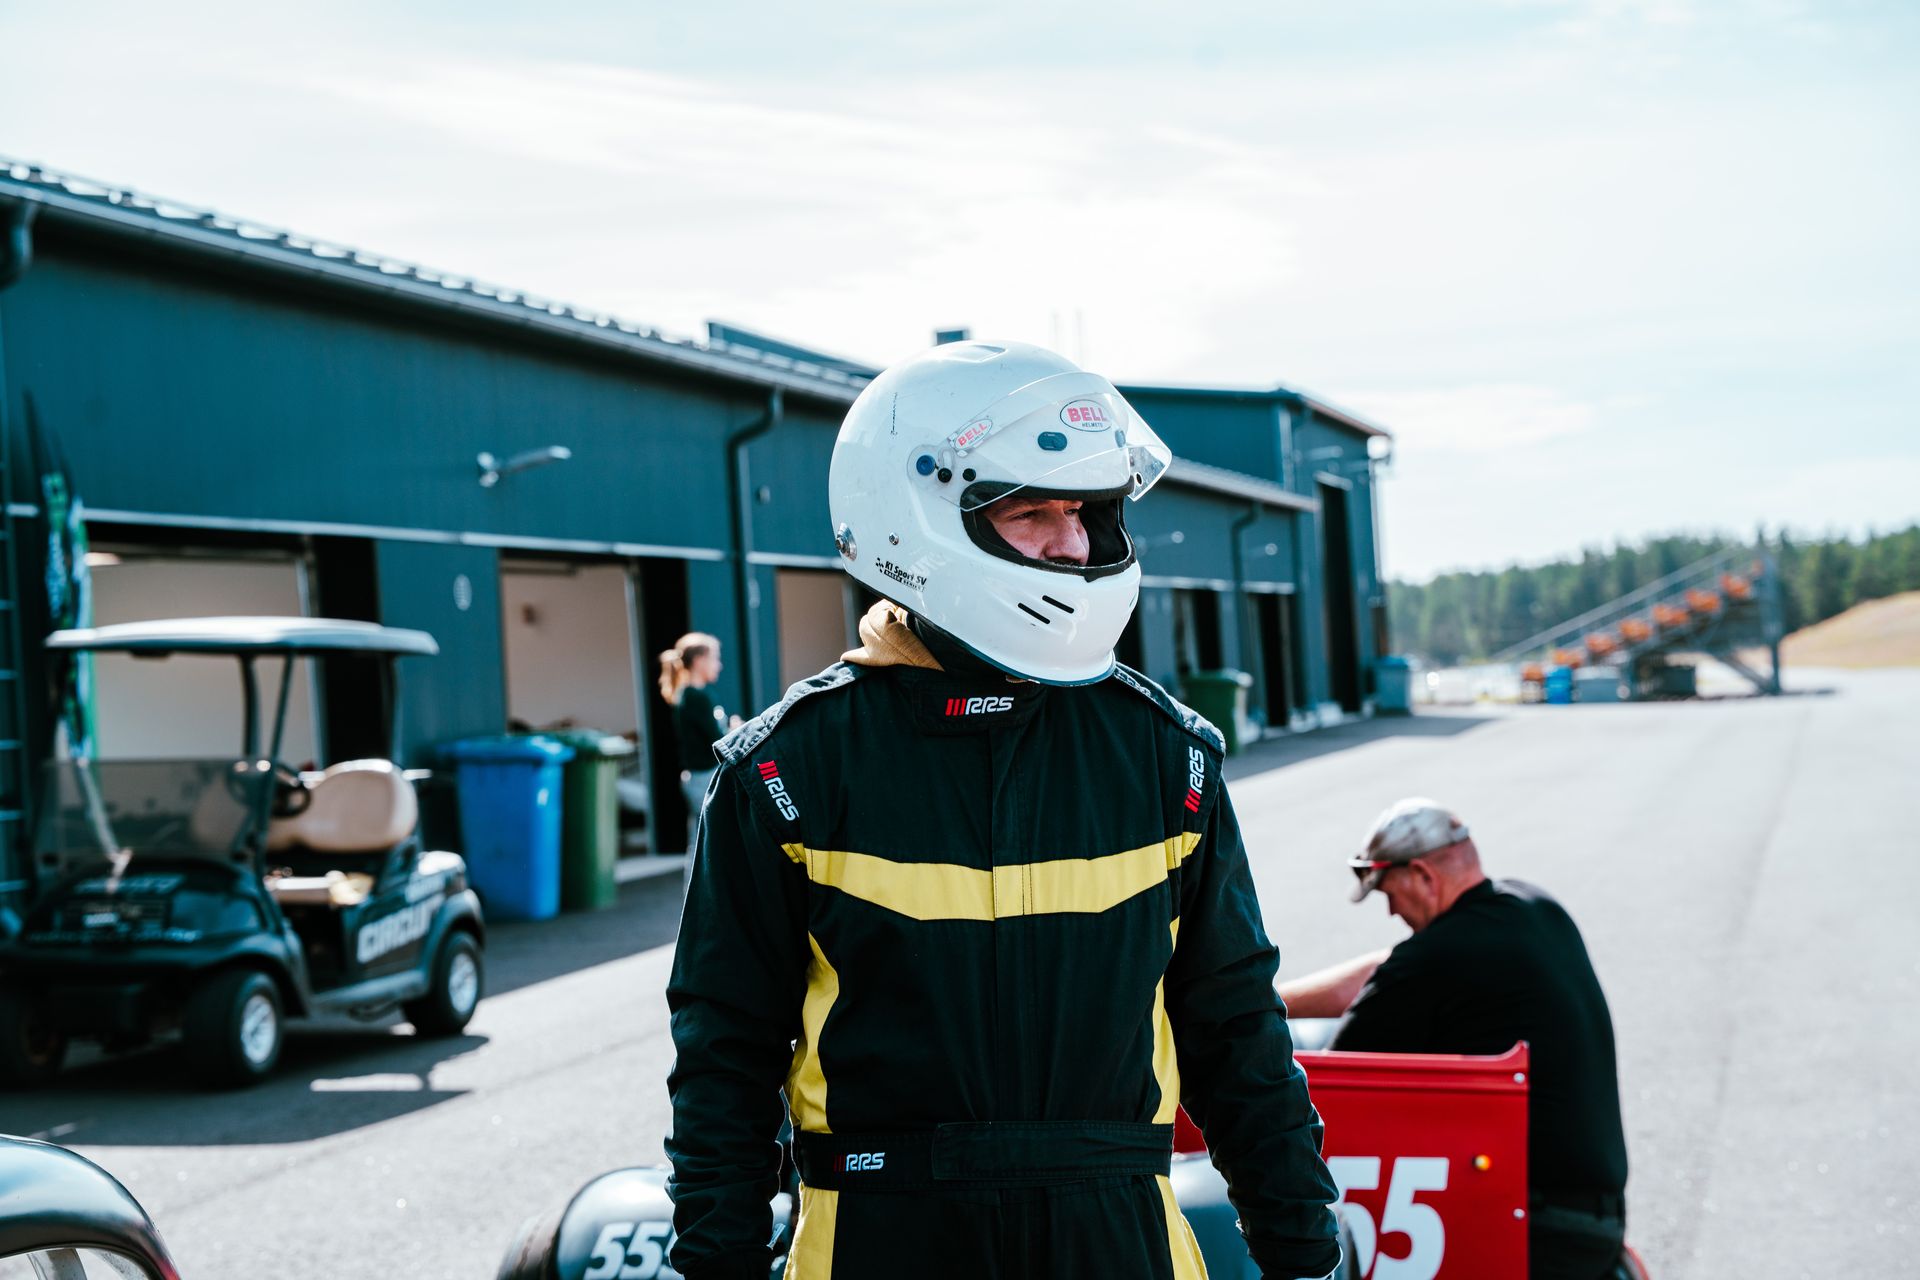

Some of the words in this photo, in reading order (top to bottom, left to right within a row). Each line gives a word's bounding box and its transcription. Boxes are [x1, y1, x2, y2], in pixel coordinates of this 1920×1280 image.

[1067, 407, 1109, 422] BELL
[958, 423, 988, 446] BELL
[916, 575, 927, 585] SV
[965, 697, 1014, 715] RRS
[1189, 746, 1205, 795] RRS
[764, 777, 799, 821] RRS
[846, 1152, 885, 1171] RRS
